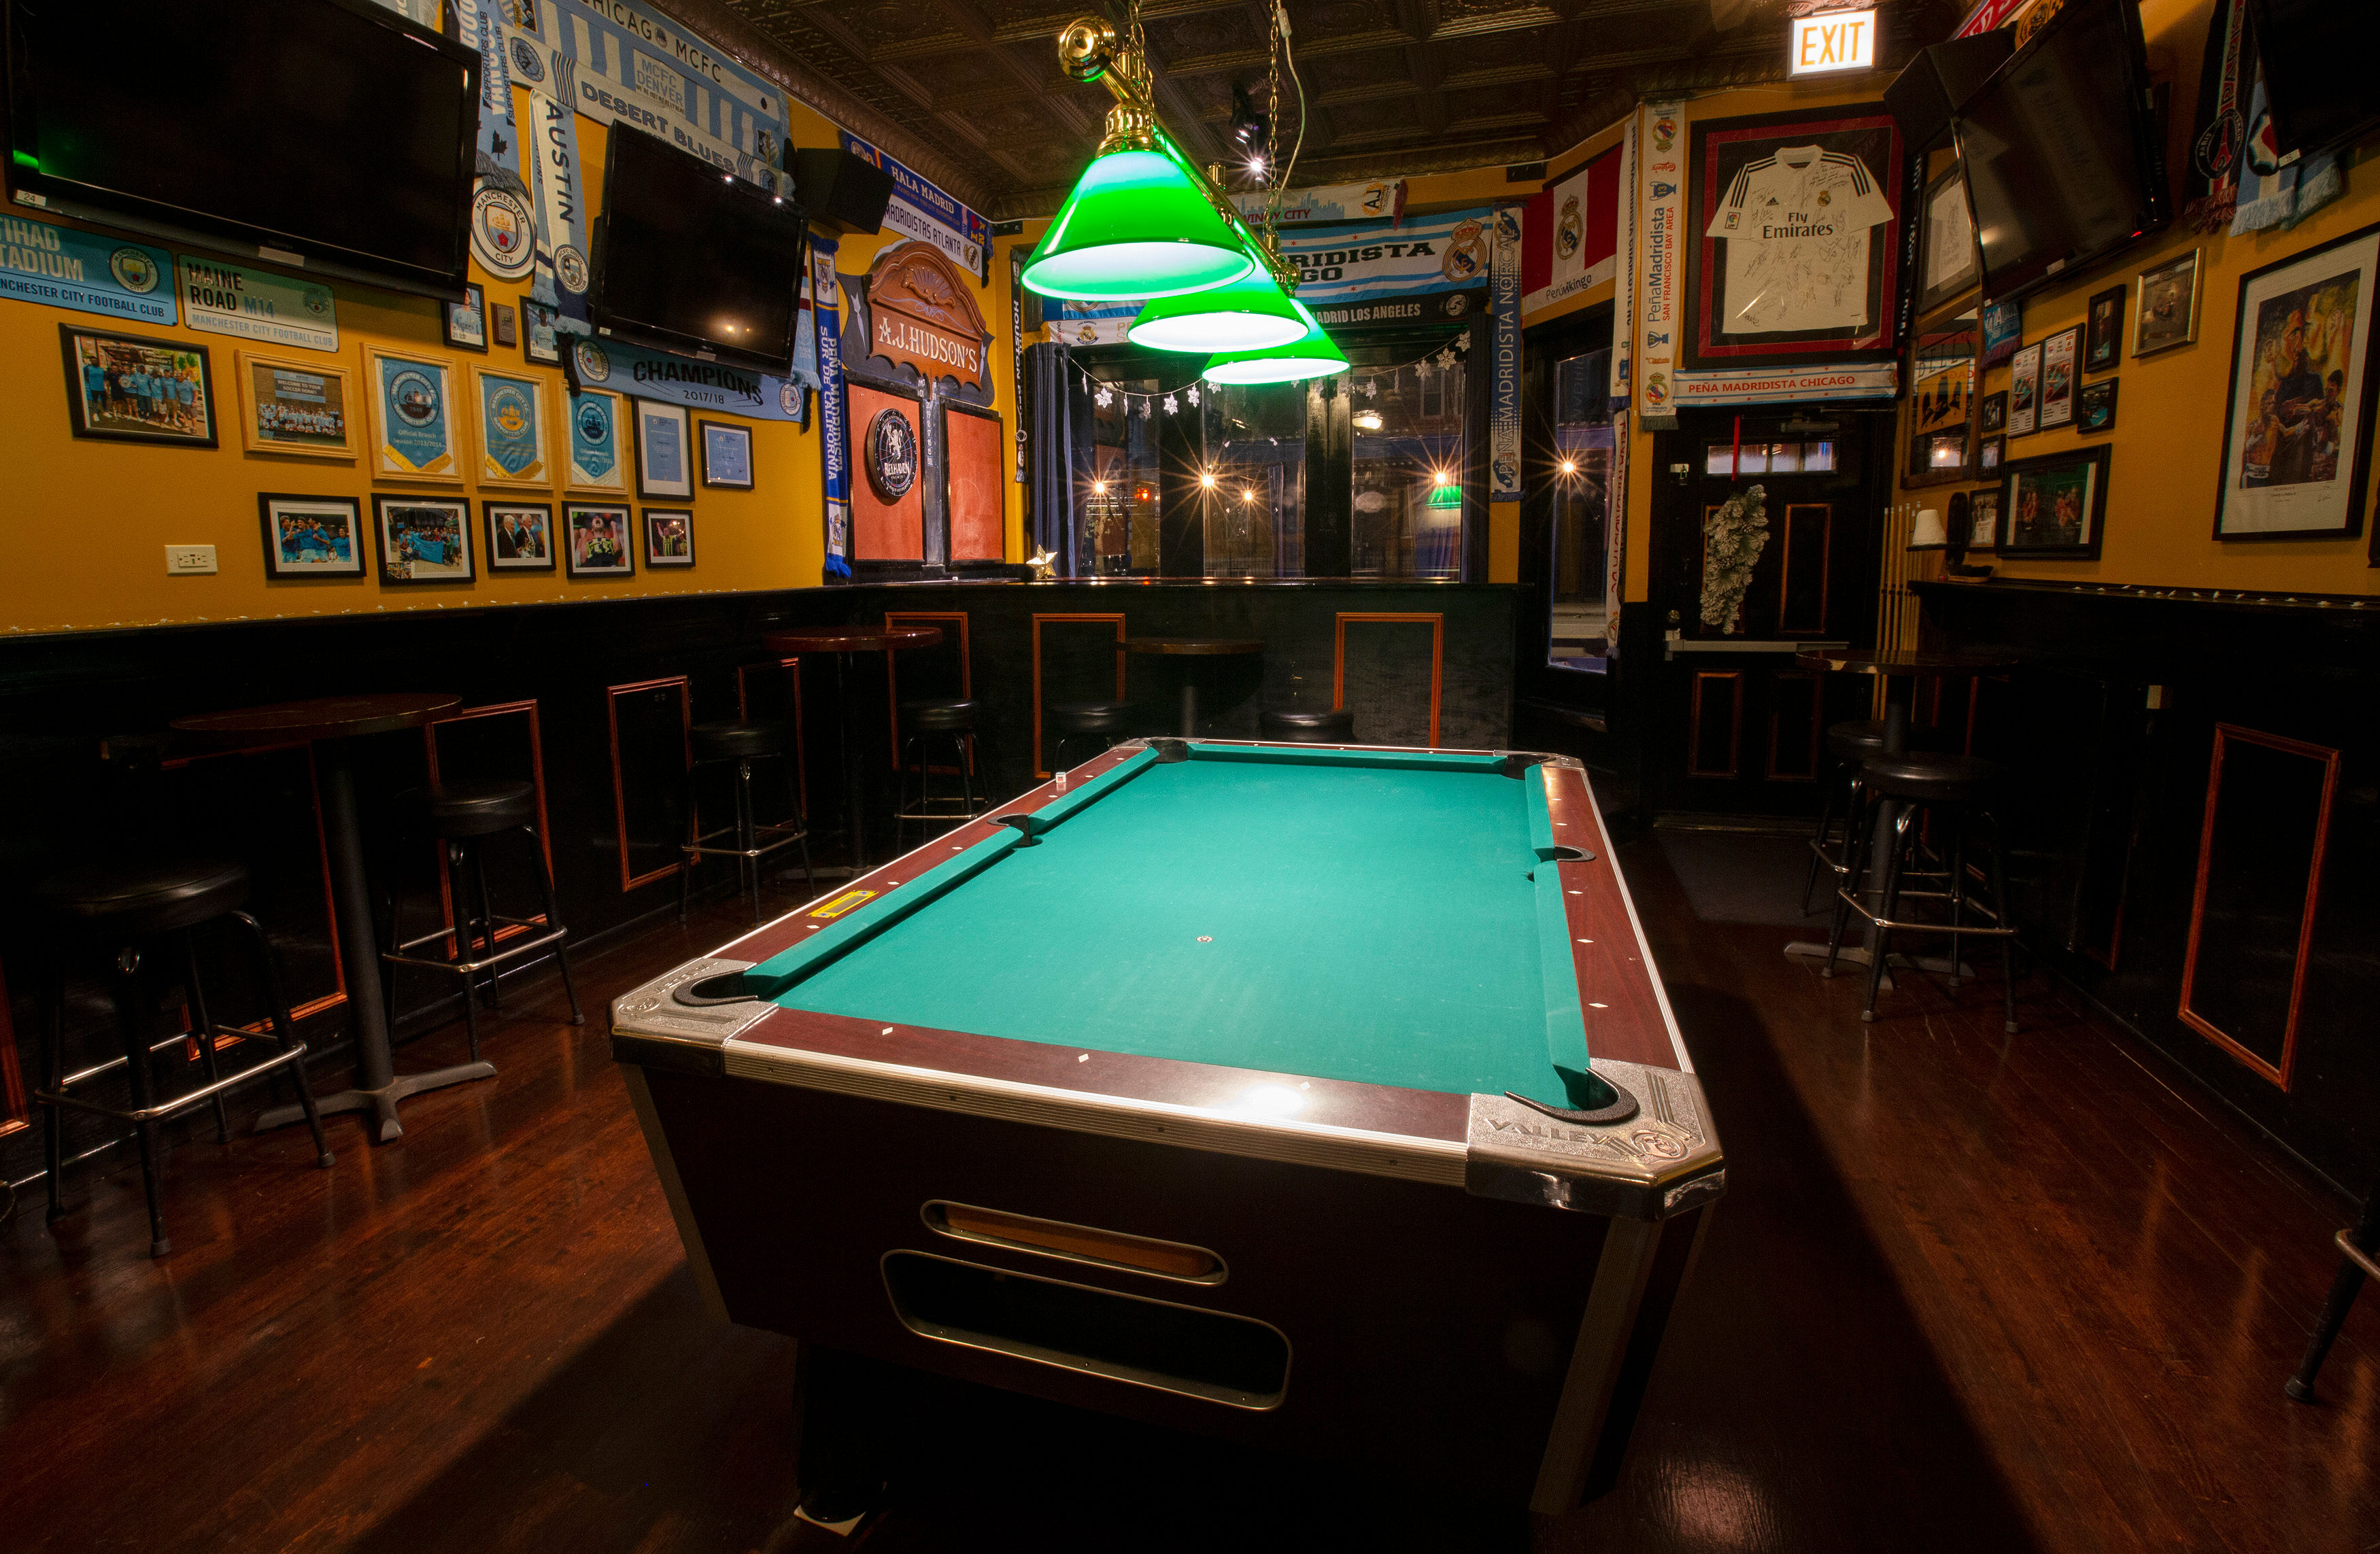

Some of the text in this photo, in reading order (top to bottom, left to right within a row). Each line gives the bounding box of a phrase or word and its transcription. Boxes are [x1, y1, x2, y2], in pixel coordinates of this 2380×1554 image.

[480, 12, 492, 101] SUPPORTERS CLUB
[1801, 21, 1865, 67] EXIT
[495, 27, 515, 119] SUPPORTERS CLUB
[642, 58, 677, 88] MCFC
[675, 39, 721, 83] MCFC
[636, 70, 683, 107] DENVER
[581, 81, 736, 172] DESERT BLUES
[545, 100, 575, 224] AUSTIN
[23, 192, 35, 203] 24
[891, 165, 954, 214] HALA MADRID
[475, 192, 526, 224] MANCHESTER
[1283, 209, 1311, 220] CITY
[1666, 207, 1674, 230] AREA
[1788, 212, 1808, 223] Fly
[0, 216, 61, 252] IHAD
[884, 203, 962, 257] MADRIDISTAS ATLANTA
[1665, 234, 1673, 249] BAY
[1763, 223, 1834, 239] Emirates
[114, 248, 154, 269] MANCHESTER
[495, 252, 513, 264] CITY
[1499, 228, 1516, 305] NORCAL
[187, 262, 243, 291] MAINE
[1663, 252, 1672, 300] FRANCISCO
[61, 289, 84, 303] CITY
[88, 294, 137, 313] FOOTBALL
[139, 303, 165, 317] CLUB
[190, 285, 274, 318] ROAD M14
[1350, 307, 1371, 322] LOS
[1372, 303, 1421, 320] ANGELES
[192, 314, 333, 346] MANCHESTER CITY FOOTBALL CLUB
[1012, 300, 1022, 385] HOUSTON
[1499, 310, 1514, 421] MADRIDISTA
[277, 379, 301, 387] WELCOME
[633, 361, 764, 406] CHAMPIONS
[683, 390, 724, 404] 2017/18
[1688, 375, 1856, 394] PEÑA MADRIDISTA CHICAGO
[393, 403, 436, 426] SUPPORTERS CLUB
[820, 326, 837, 481] SUR DE CALIFORNIA
[828, 337, 843, 472] PEÑA MADRIDISTA
[884, 461, 910, 477] BELHAVEN
[1485, 1118, 1611, 1145] VALLEY
